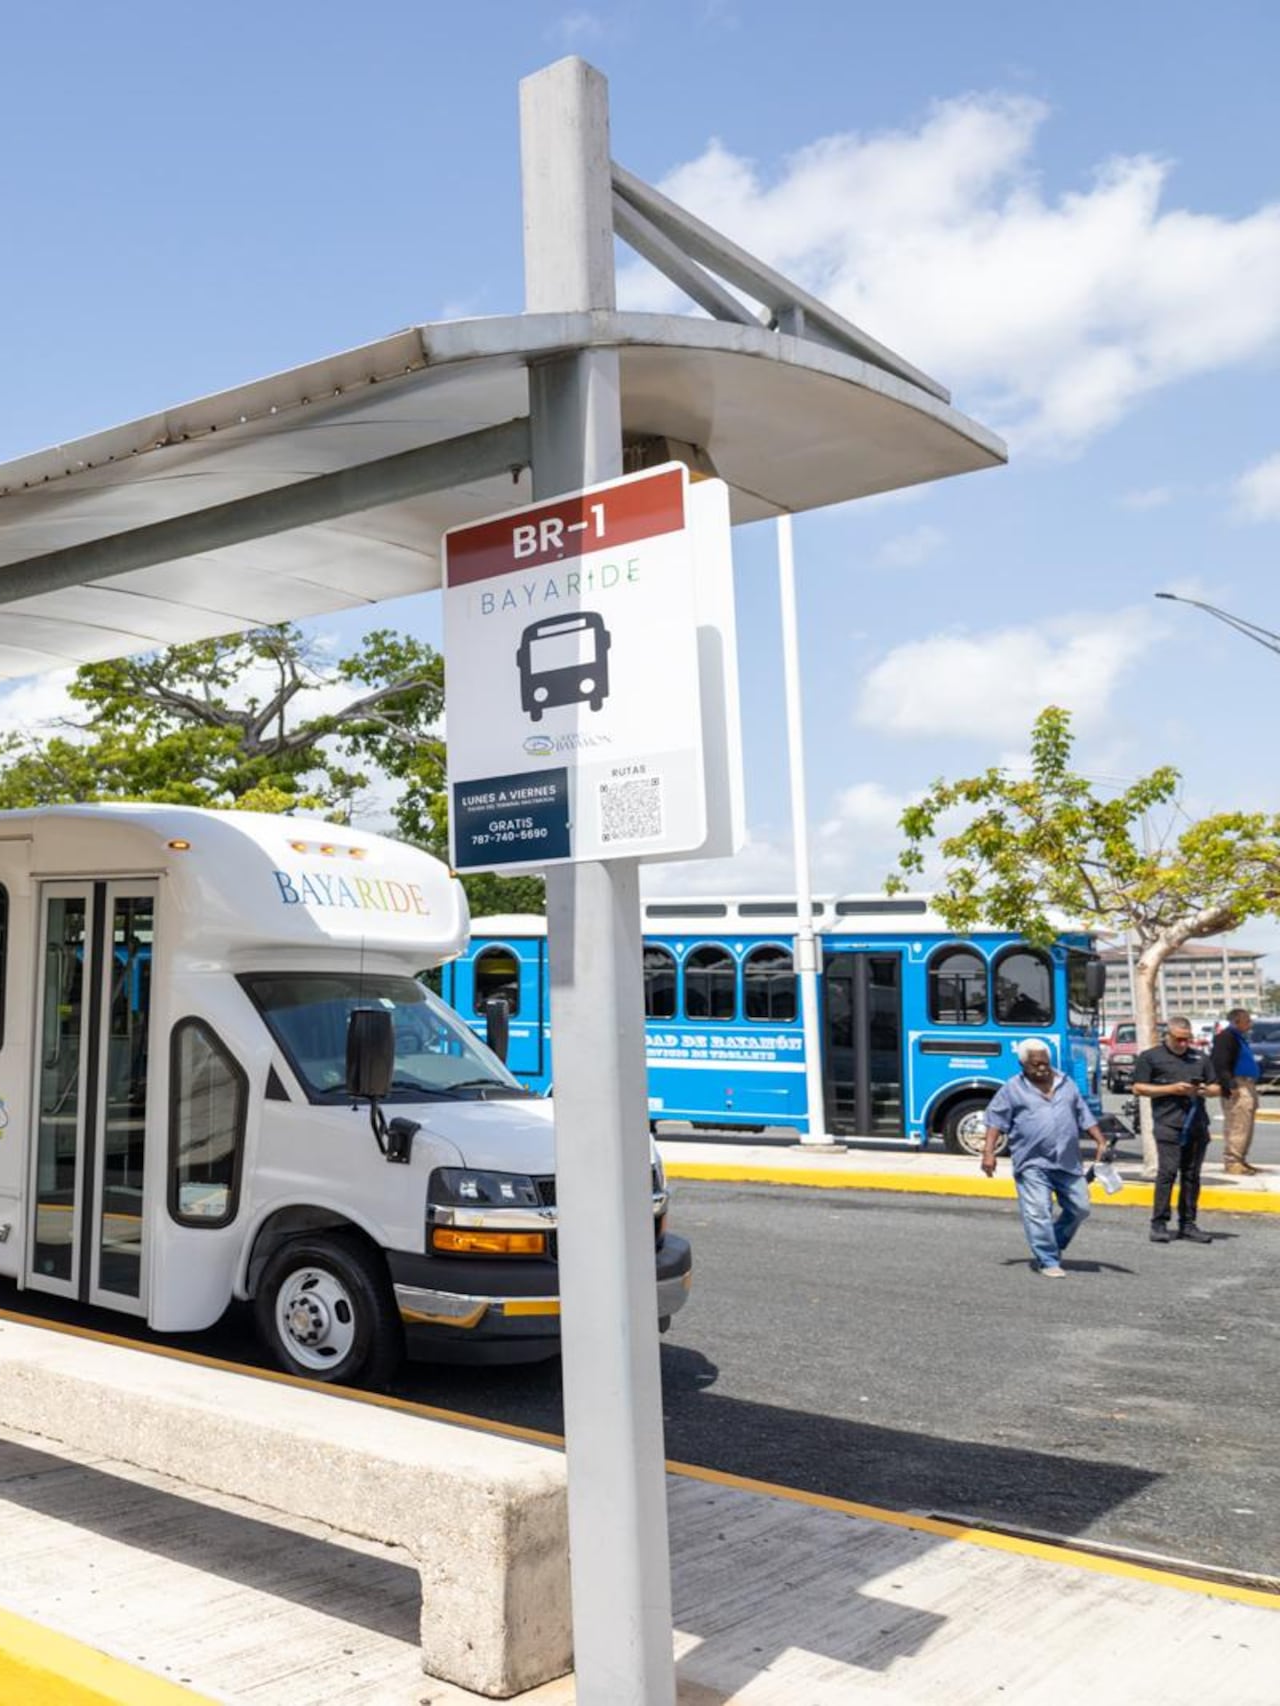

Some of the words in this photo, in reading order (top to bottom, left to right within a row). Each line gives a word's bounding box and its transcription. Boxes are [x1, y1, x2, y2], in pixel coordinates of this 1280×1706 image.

[512, 503, 606, 559] BR-1
[480, 558, 641, 616] BAYARIDE
[611, 765, 647, 777] RUTAS
[461, 793, 496, 806] LUNES
[498, 791, 507, 801] A
[509, 784, 557, 800] VIERNES
[488, 817, 534, 833] GRATIS
[272, 870, 431, 916] BAYARIDE
[645, 1034, 679, 1048] DAD
[681, 1035, 707, 1048] DE
